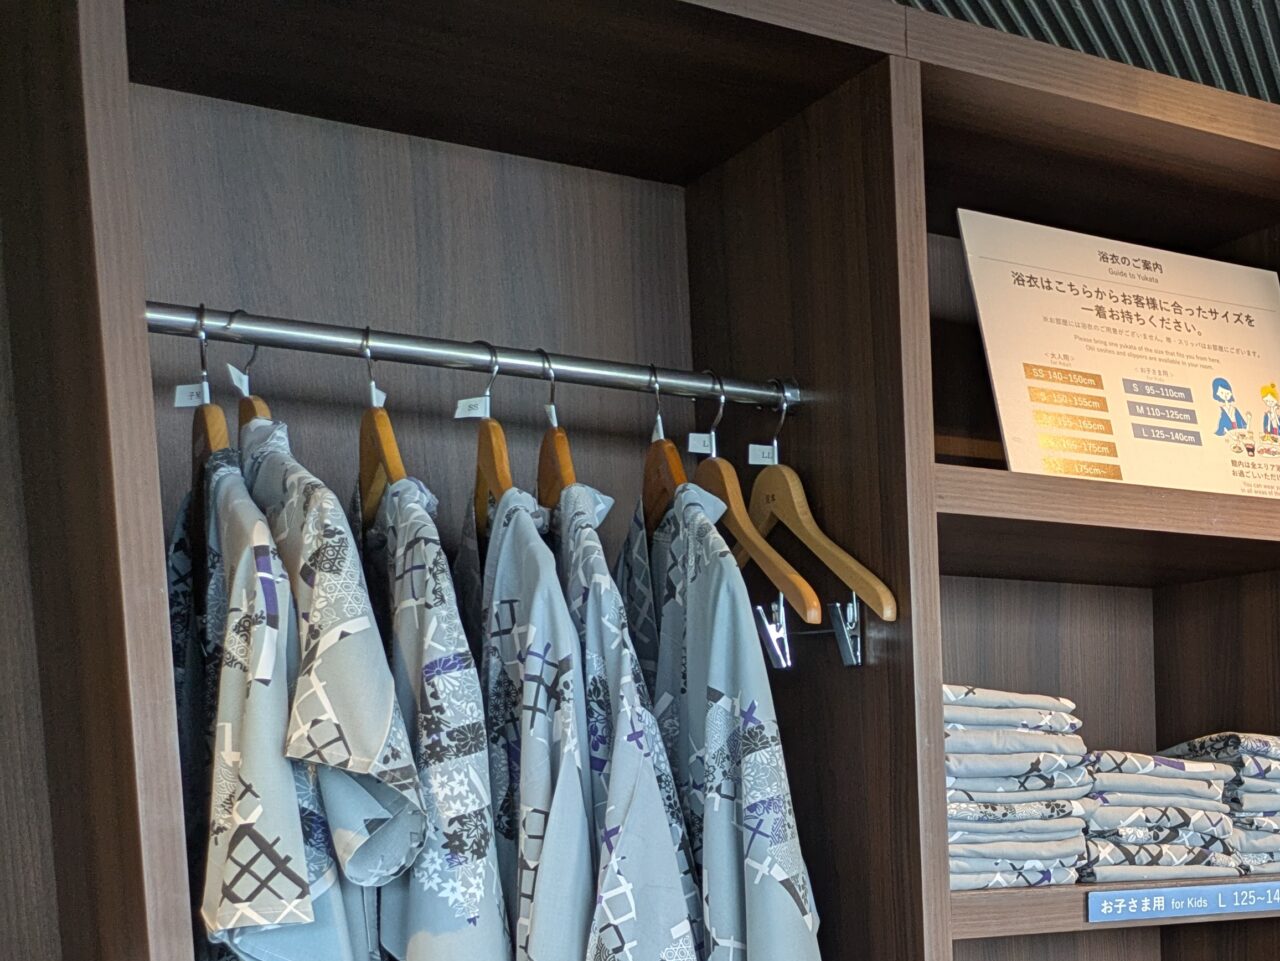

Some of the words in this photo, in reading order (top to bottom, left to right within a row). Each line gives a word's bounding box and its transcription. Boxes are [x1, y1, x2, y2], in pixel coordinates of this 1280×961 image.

[1097, 250, 1163, 274] 浴衣のご案内
[1108, 267, 1127, 279] Guide
[1129, 271, 1136, 280] to
[1137, 273, 1159, 284] Yukata
[1010, 270, 1256, 328] 浴衣はこちらからお客様に合ったサイズを
[1081, 304, 1203, 337] 一着お持ちください。
[1032, 368, 1045, 378] SS
[1132, 383, 1140, 393] S
[467, 403, 479, 412] SS
[1136, 405, 1145, 415] M
[1142, 427, 1149, 437] L
[1100, 896, 1165, 914] お子さま用
[1171, 898, 1185, 910] for
[1187, 897, 1208, 909] Kids
[1218, 893, 1226, 908] L
